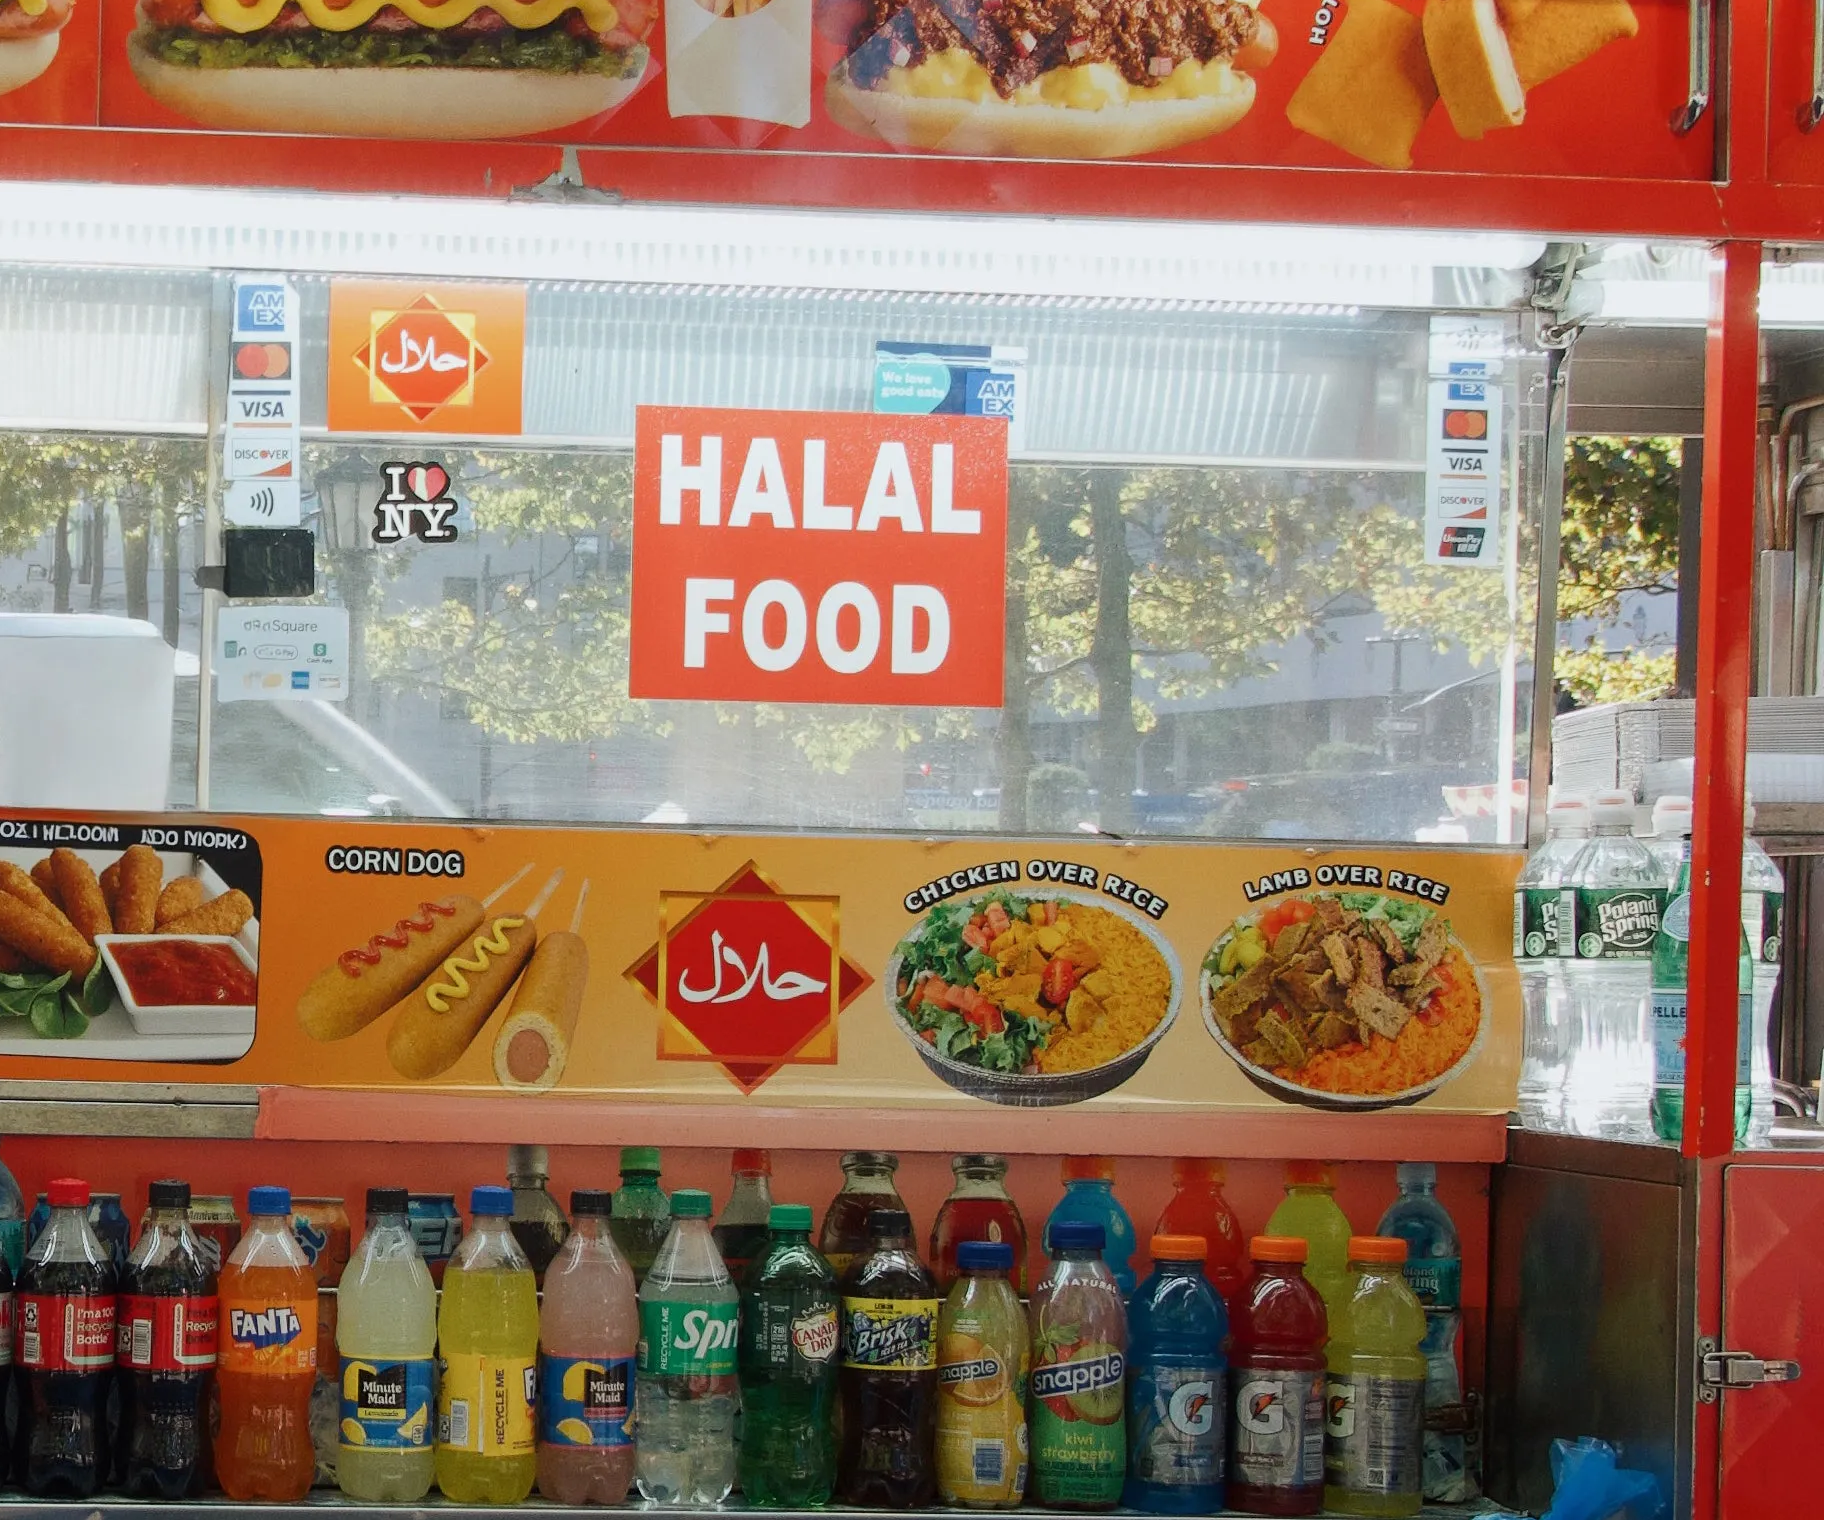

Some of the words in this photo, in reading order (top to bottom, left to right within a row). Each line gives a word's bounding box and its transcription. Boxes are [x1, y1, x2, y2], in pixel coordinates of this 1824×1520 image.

[251, 293, 284, 309] AM
[256, 310, 284, 324] EX
[380, 328, 467, 375] حلال
[881, 371, 903, 383] We
[880, 387, 914, 398] good
[979, 380, 1014, 397] AM
[240, 400, 285, 419] VISA
[983, 398, 1014, 413] EX
[234, 448, 289, 461] DISCOVER
[1447, 456, 1482, 471] VISA
[386, 467, 406, 502] I
[659, 434, 981, 535] HALAL
[272, 620, 318, 634] Square
[683, 577, 951, 675] FOOD
[327, 848, 399, 874] CORN
[405, 851, 465, 877] DOG
[903, 860, 1020, 912] CHICKEN
[1025, 858, 1101, 890] OVER
[1102, 871, 1169, 920] RICE
[1244, 869, 1310, 901] LAMB
[1316, 863, 1384, 888] OVER
[1386, 869, 1450, 906] RICE
[1597, 893, 1658, 922] Poland
[1600, 913, 1659, 943] Spring
[679, 927, 827, 1006] حلال
[660, 1326, 670, 1370] RECYCLE
[810, 1334, 835, 1354] DRY
[496, 1369, 505, 1390] ME
[1034, 1356, 1122, 1395] snapple
[361, 1381, 403, 1394] Minute
[588, 1380, 626, 1393] Minute
[366, 1392, 397, 1405] Maid
[593, 1391, 622, 1404] Maid
[496, 1391, 505, 1446] RECYCLE
[1063, 1432, 1095, 1446] kiwi
